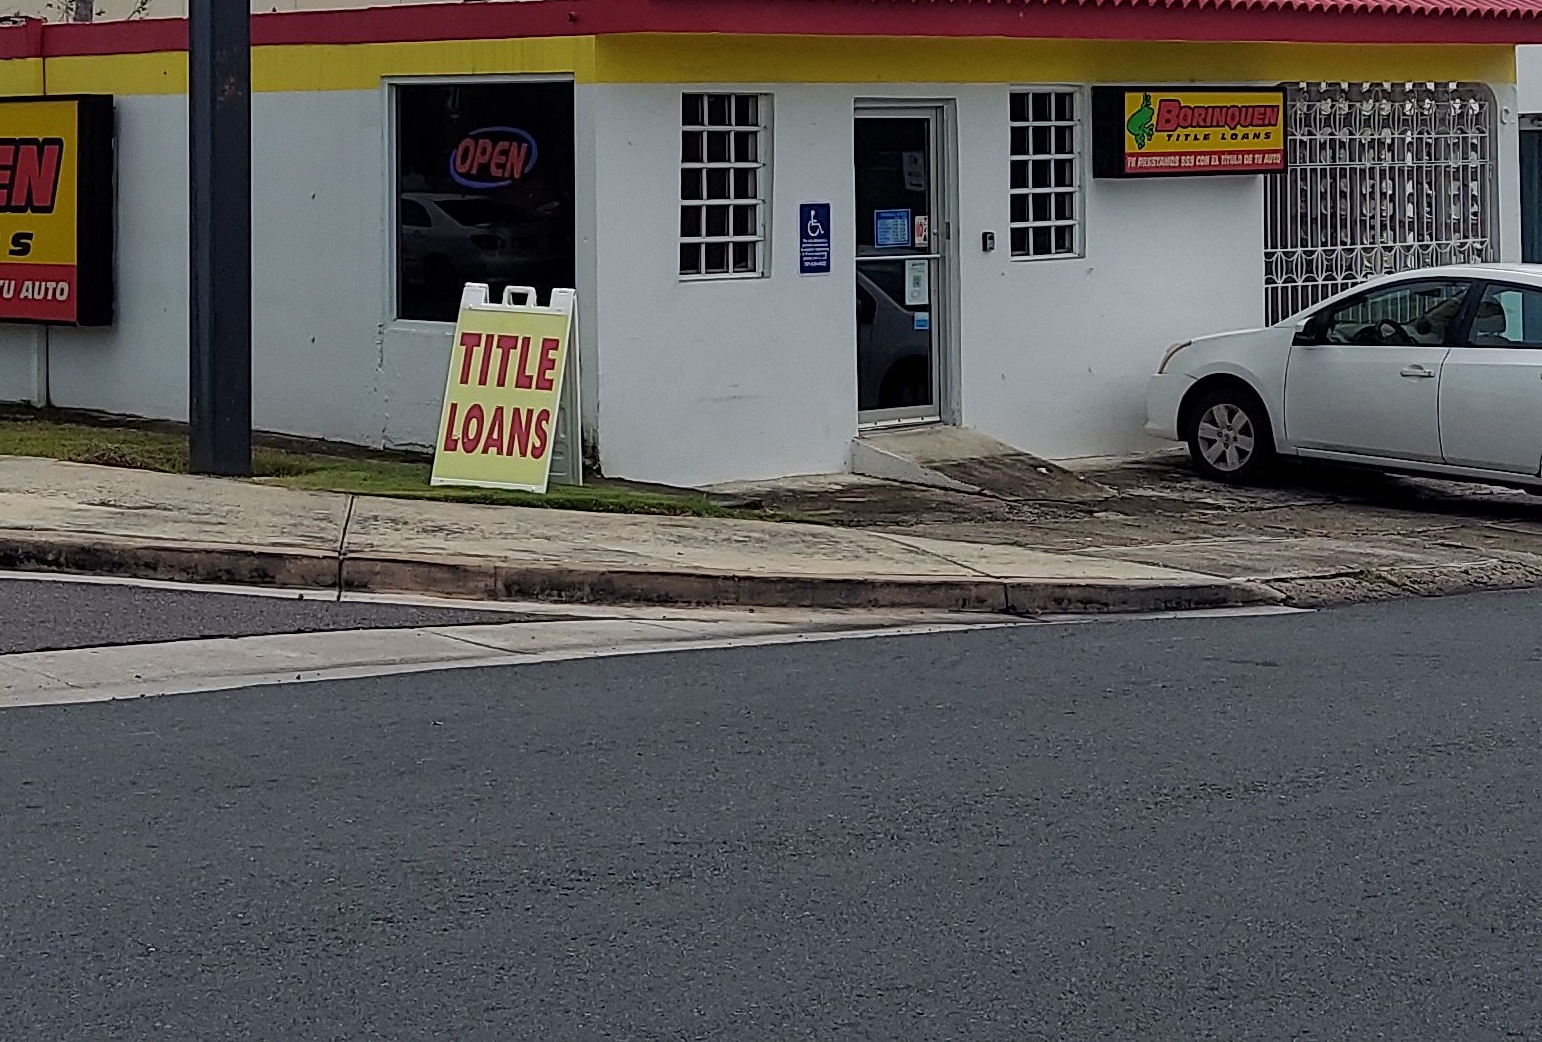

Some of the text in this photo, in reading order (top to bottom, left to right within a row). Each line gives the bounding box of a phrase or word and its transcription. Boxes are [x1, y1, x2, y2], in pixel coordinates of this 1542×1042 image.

[1155, 98, 1280, 132] BORINQUEN
[1166, 131, 1272, 142] TITLE LOANS
[455, 138, 528, 179] OPEN
[19, 280, 69, 301] AUTO
[460, 332, 560, 391] TITLE
[443, 402, 550, 459] LOANS
